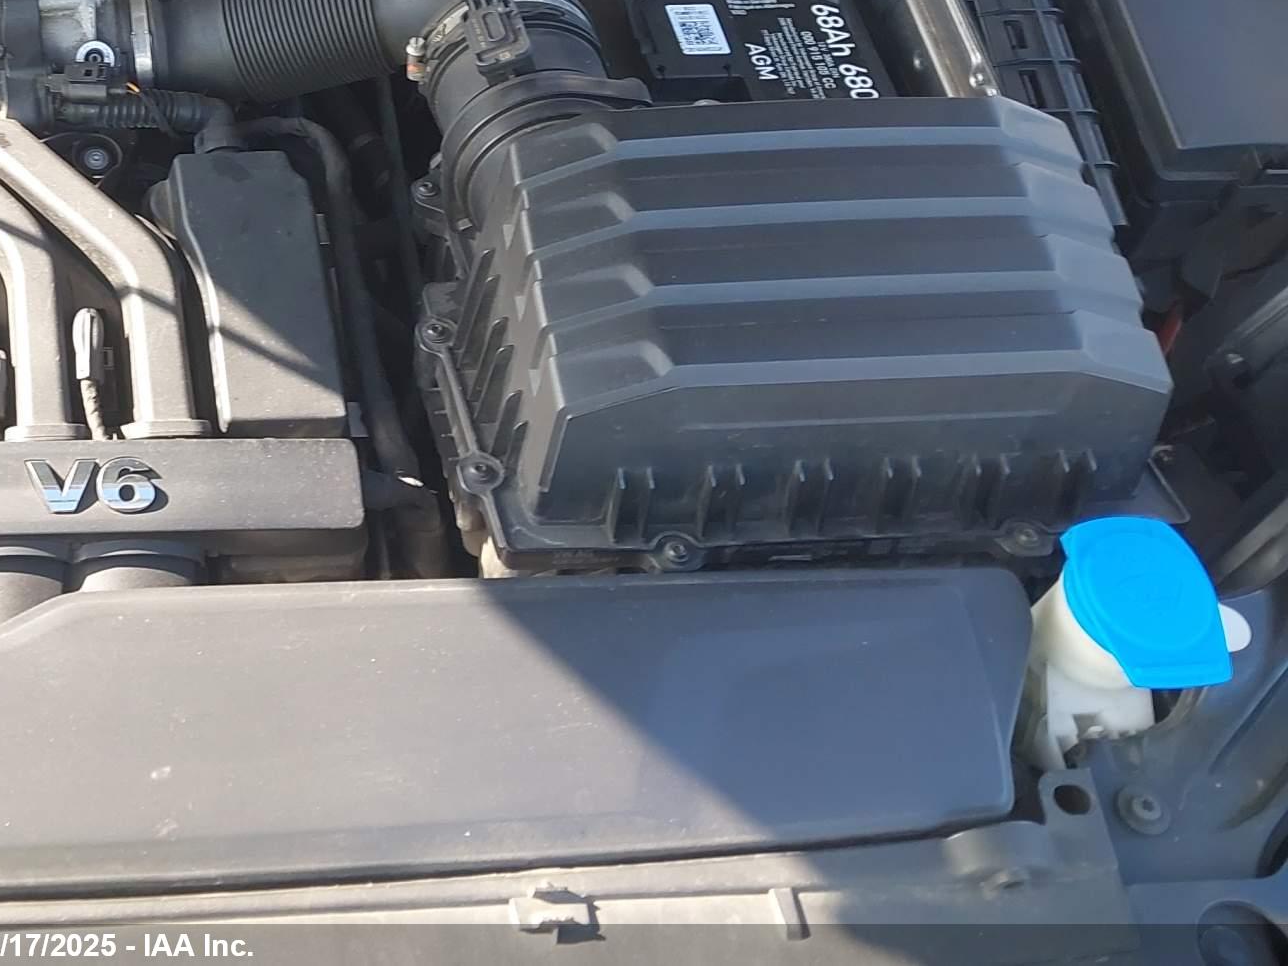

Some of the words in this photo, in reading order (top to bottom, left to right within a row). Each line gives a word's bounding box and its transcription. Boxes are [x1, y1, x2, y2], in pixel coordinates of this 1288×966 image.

[744, 43, 779, 80] AGM
[811, 4, 856, 57] 68Ah
[839, 64, 880, 99] 680
[24, 456, 164, 515] V6
